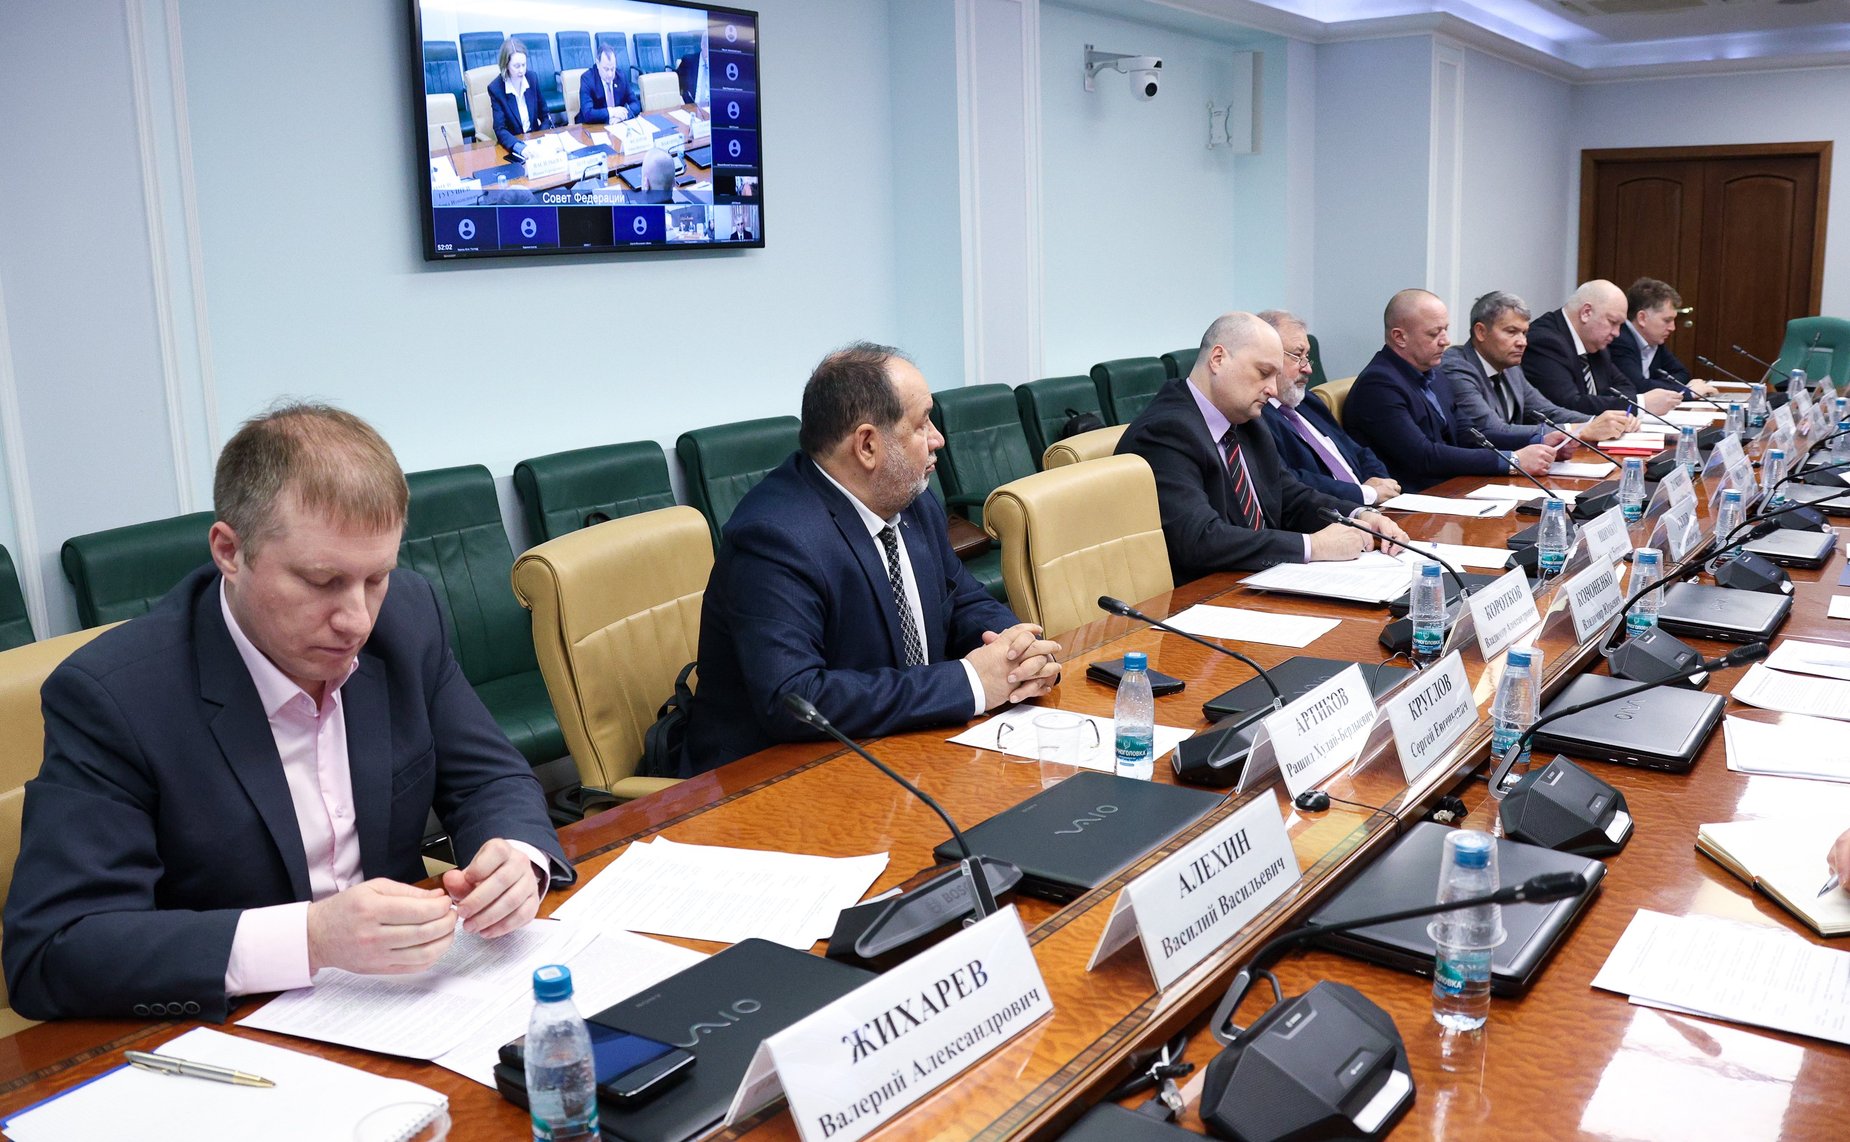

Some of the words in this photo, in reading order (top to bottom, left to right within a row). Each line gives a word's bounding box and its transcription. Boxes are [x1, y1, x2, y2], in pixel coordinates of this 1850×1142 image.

[542, 192, 571, 204] Совет
[574, 192, 625, 206] Федерации
[437, 243, 453, 251] 52:02
[1484, 584, 1523, 621] КОРОТКОВ
[1575, 570, 1613, 608] КОНОНЕНКО
[1295, 687, 1349, 737] АРТИКОВ
[1408, 673, 1452, 722] КРУГЛОВ
[1410, 728, 1436, 758] Сергей
[1433, 700, 1469, 738] Евгеньевич
[1054, 804, 1119, 834] VAIO
[1177, 828, 1252, 899] АЛЕХИН
[941, 880, 971, 904] BOSC
[1160, 903, 1219, 960] Василий
[1217, 857, 1286, 917] Васильевич
[841, 958, 989, 1066] ЖИХАРЕВ
[817, 1072, 908, 1141] Валерий
[912, 987, 1042, 1084] Александрович
